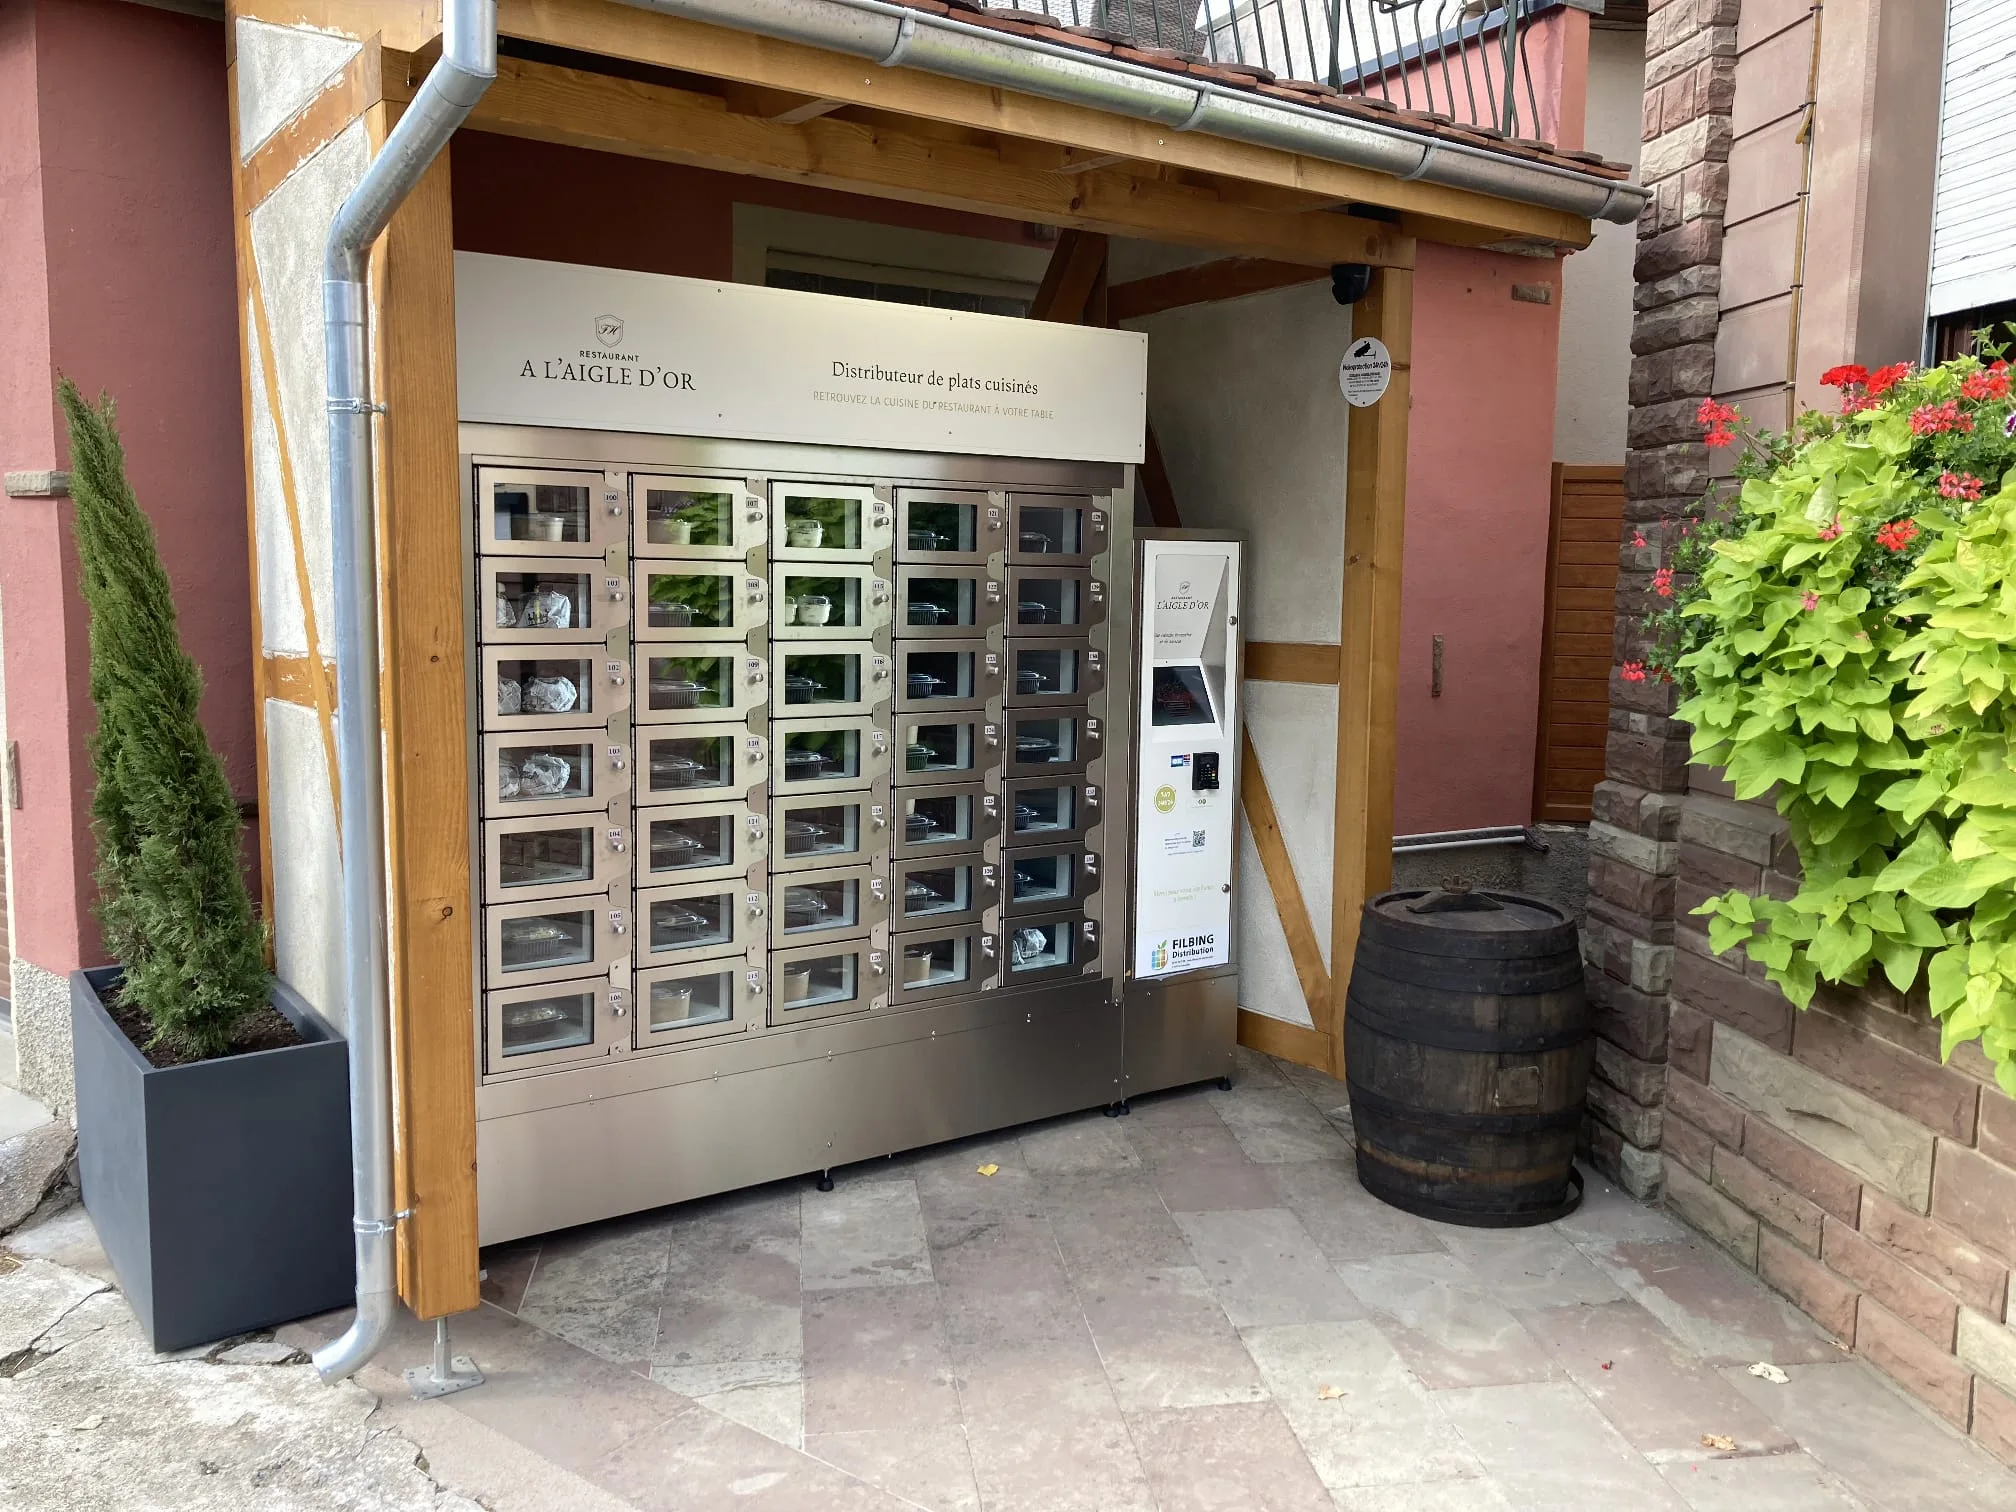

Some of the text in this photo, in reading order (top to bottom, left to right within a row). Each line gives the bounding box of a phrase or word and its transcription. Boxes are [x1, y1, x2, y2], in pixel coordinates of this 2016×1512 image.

[579, 350, 640, 362] RESTAURANT
[520, 358, 696, 390] A L'AIGLE D'OR
[832, 361, 1038, 395] Distributeur de plats cuisinés
[813, 391, 867, 405] RETROUVEZ
[870, 395, 880, 406] LA
[884, 396, 919, 409] CUISINE
[922, 400, 934, 410] DU
[938, 401, 991, 415] RESTAURANT
[1003, 406, 1029, 418] VOTRE
[1031, 408, 1055, 420] TABLE
[1172, 934, 1214, 949] FILBING
[1172, 946, 1214, 958] Distribution
